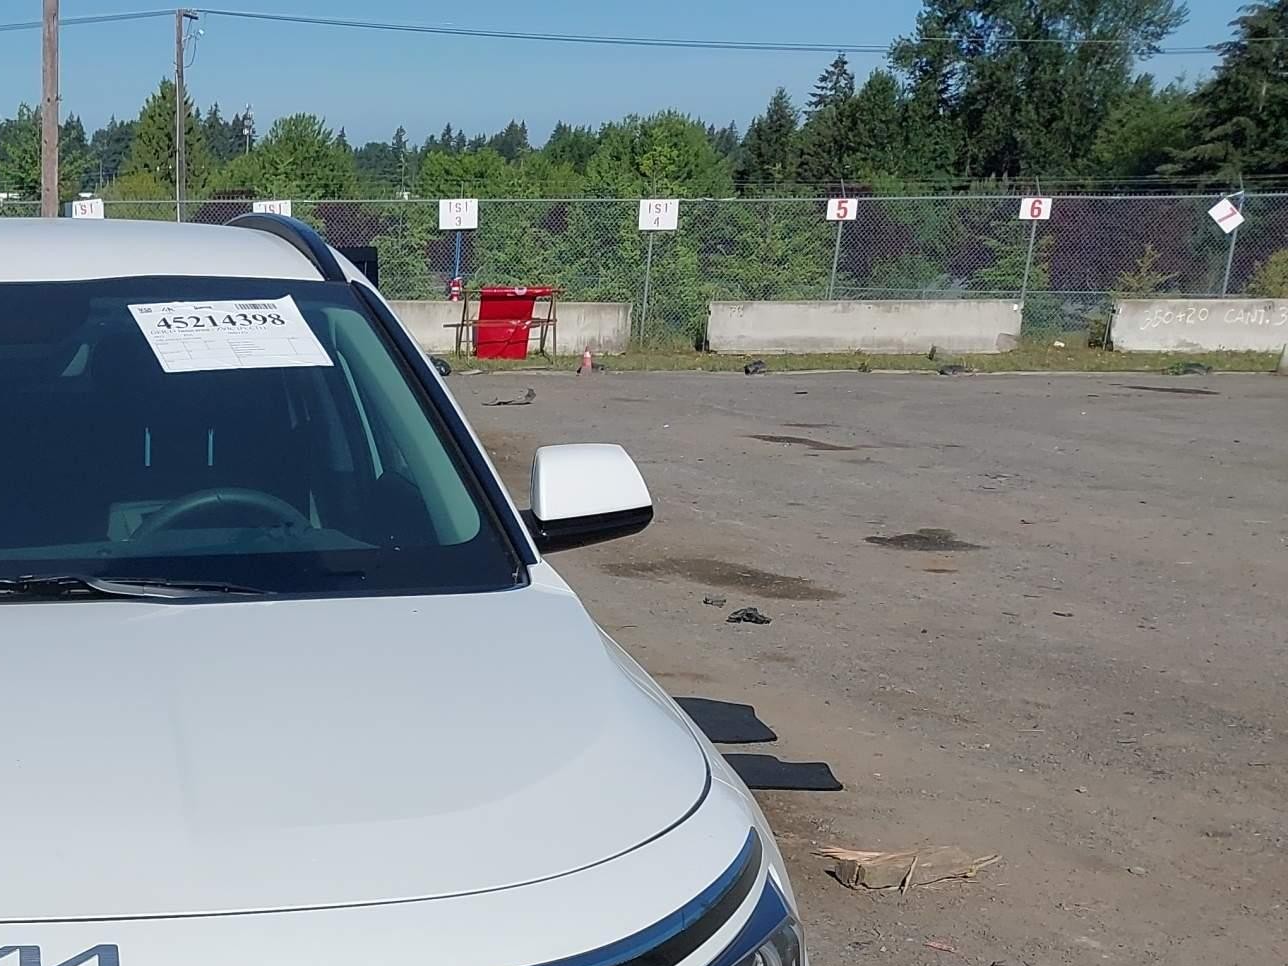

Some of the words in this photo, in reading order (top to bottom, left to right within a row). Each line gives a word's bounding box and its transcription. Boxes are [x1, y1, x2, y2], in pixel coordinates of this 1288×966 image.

[836, 200, 849, 219] 5
[1030, 199, 1043, 218] 6
[455, 216, 462, 227] 3
[653, 217, 660, 228] 4
[157, 312, 285, 330] 45214398
